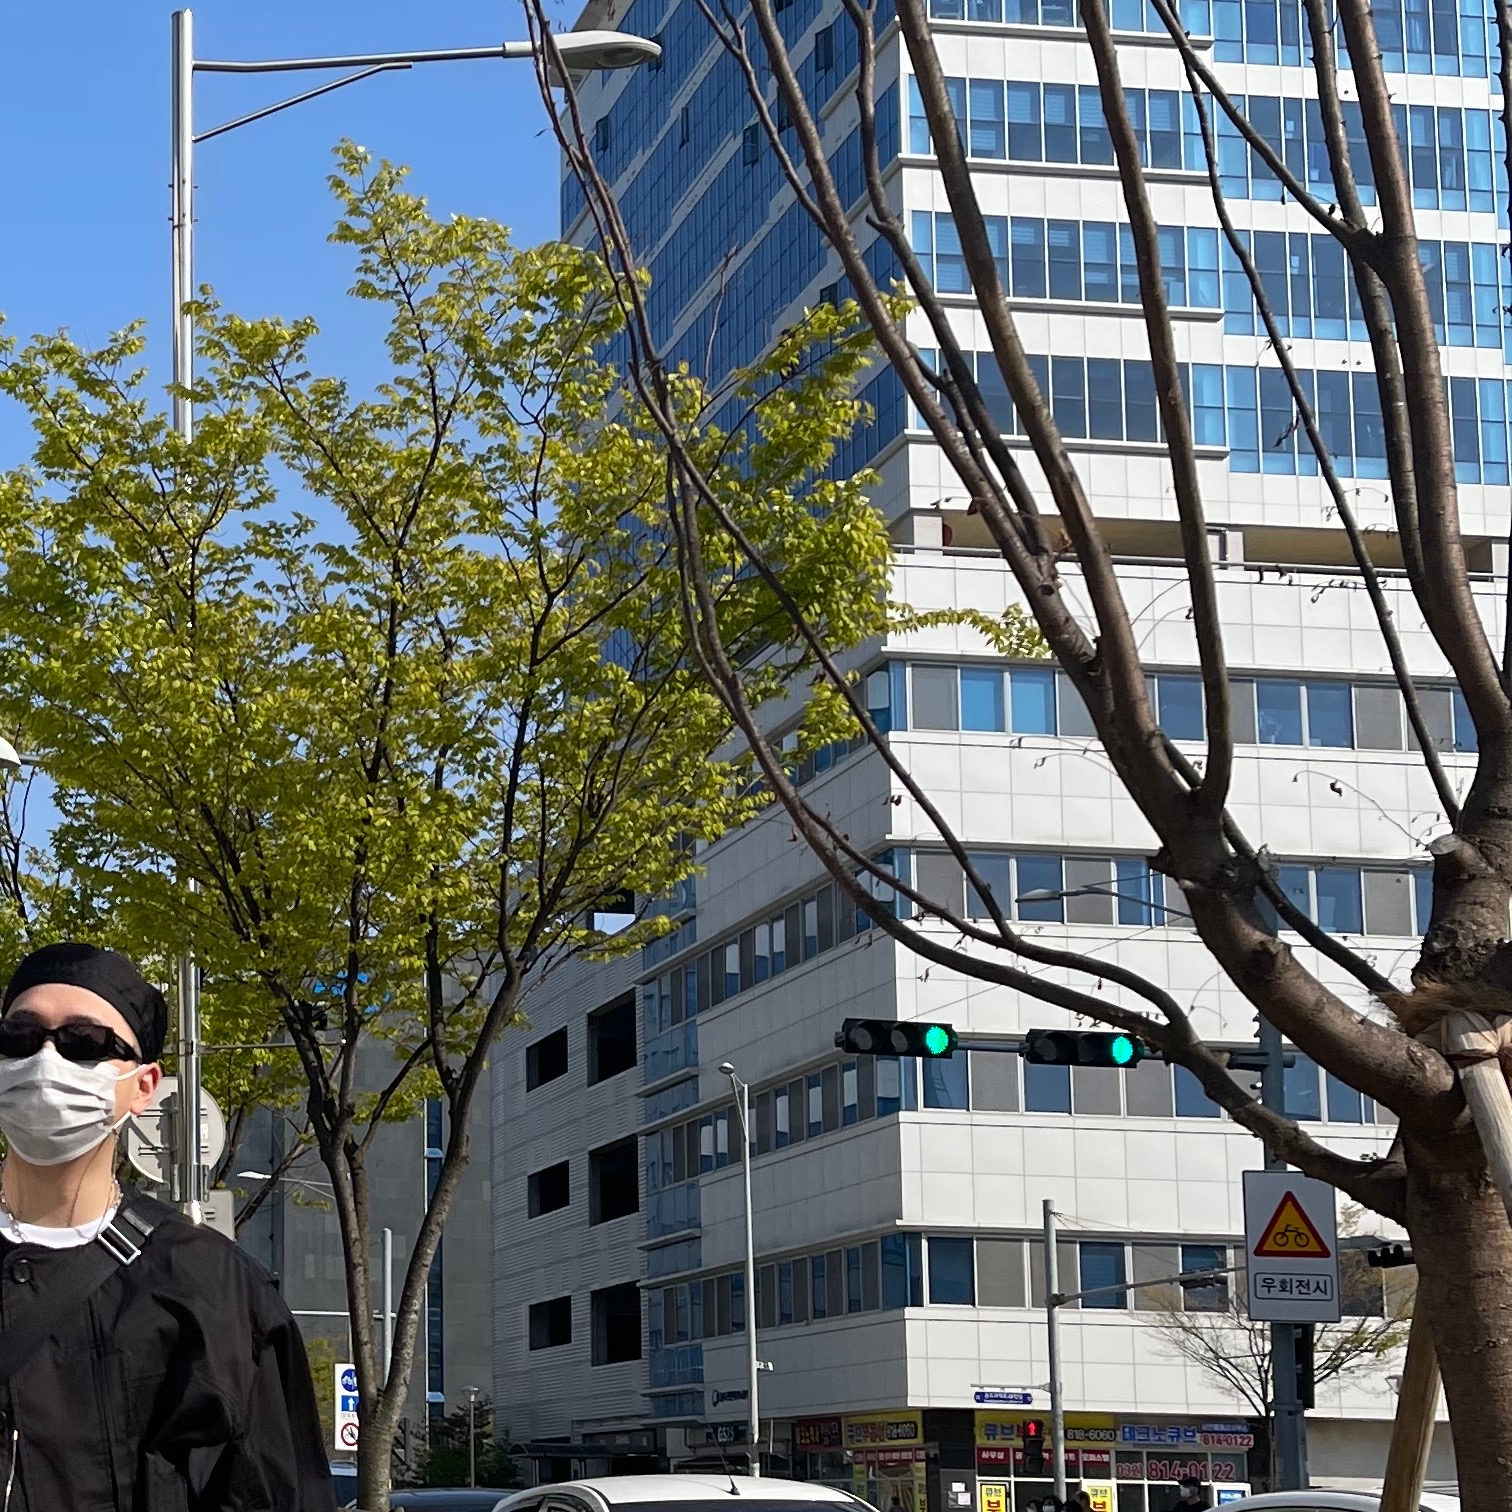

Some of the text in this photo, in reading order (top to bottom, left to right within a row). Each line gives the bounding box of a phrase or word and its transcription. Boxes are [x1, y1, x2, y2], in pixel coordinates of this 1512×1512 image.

[1260, 1277, 1328, 1296] 우회전시
[1067, 1428, 1115, 1440] 818-6060
[1201, 1434, 1253, 1447] 814-0122
